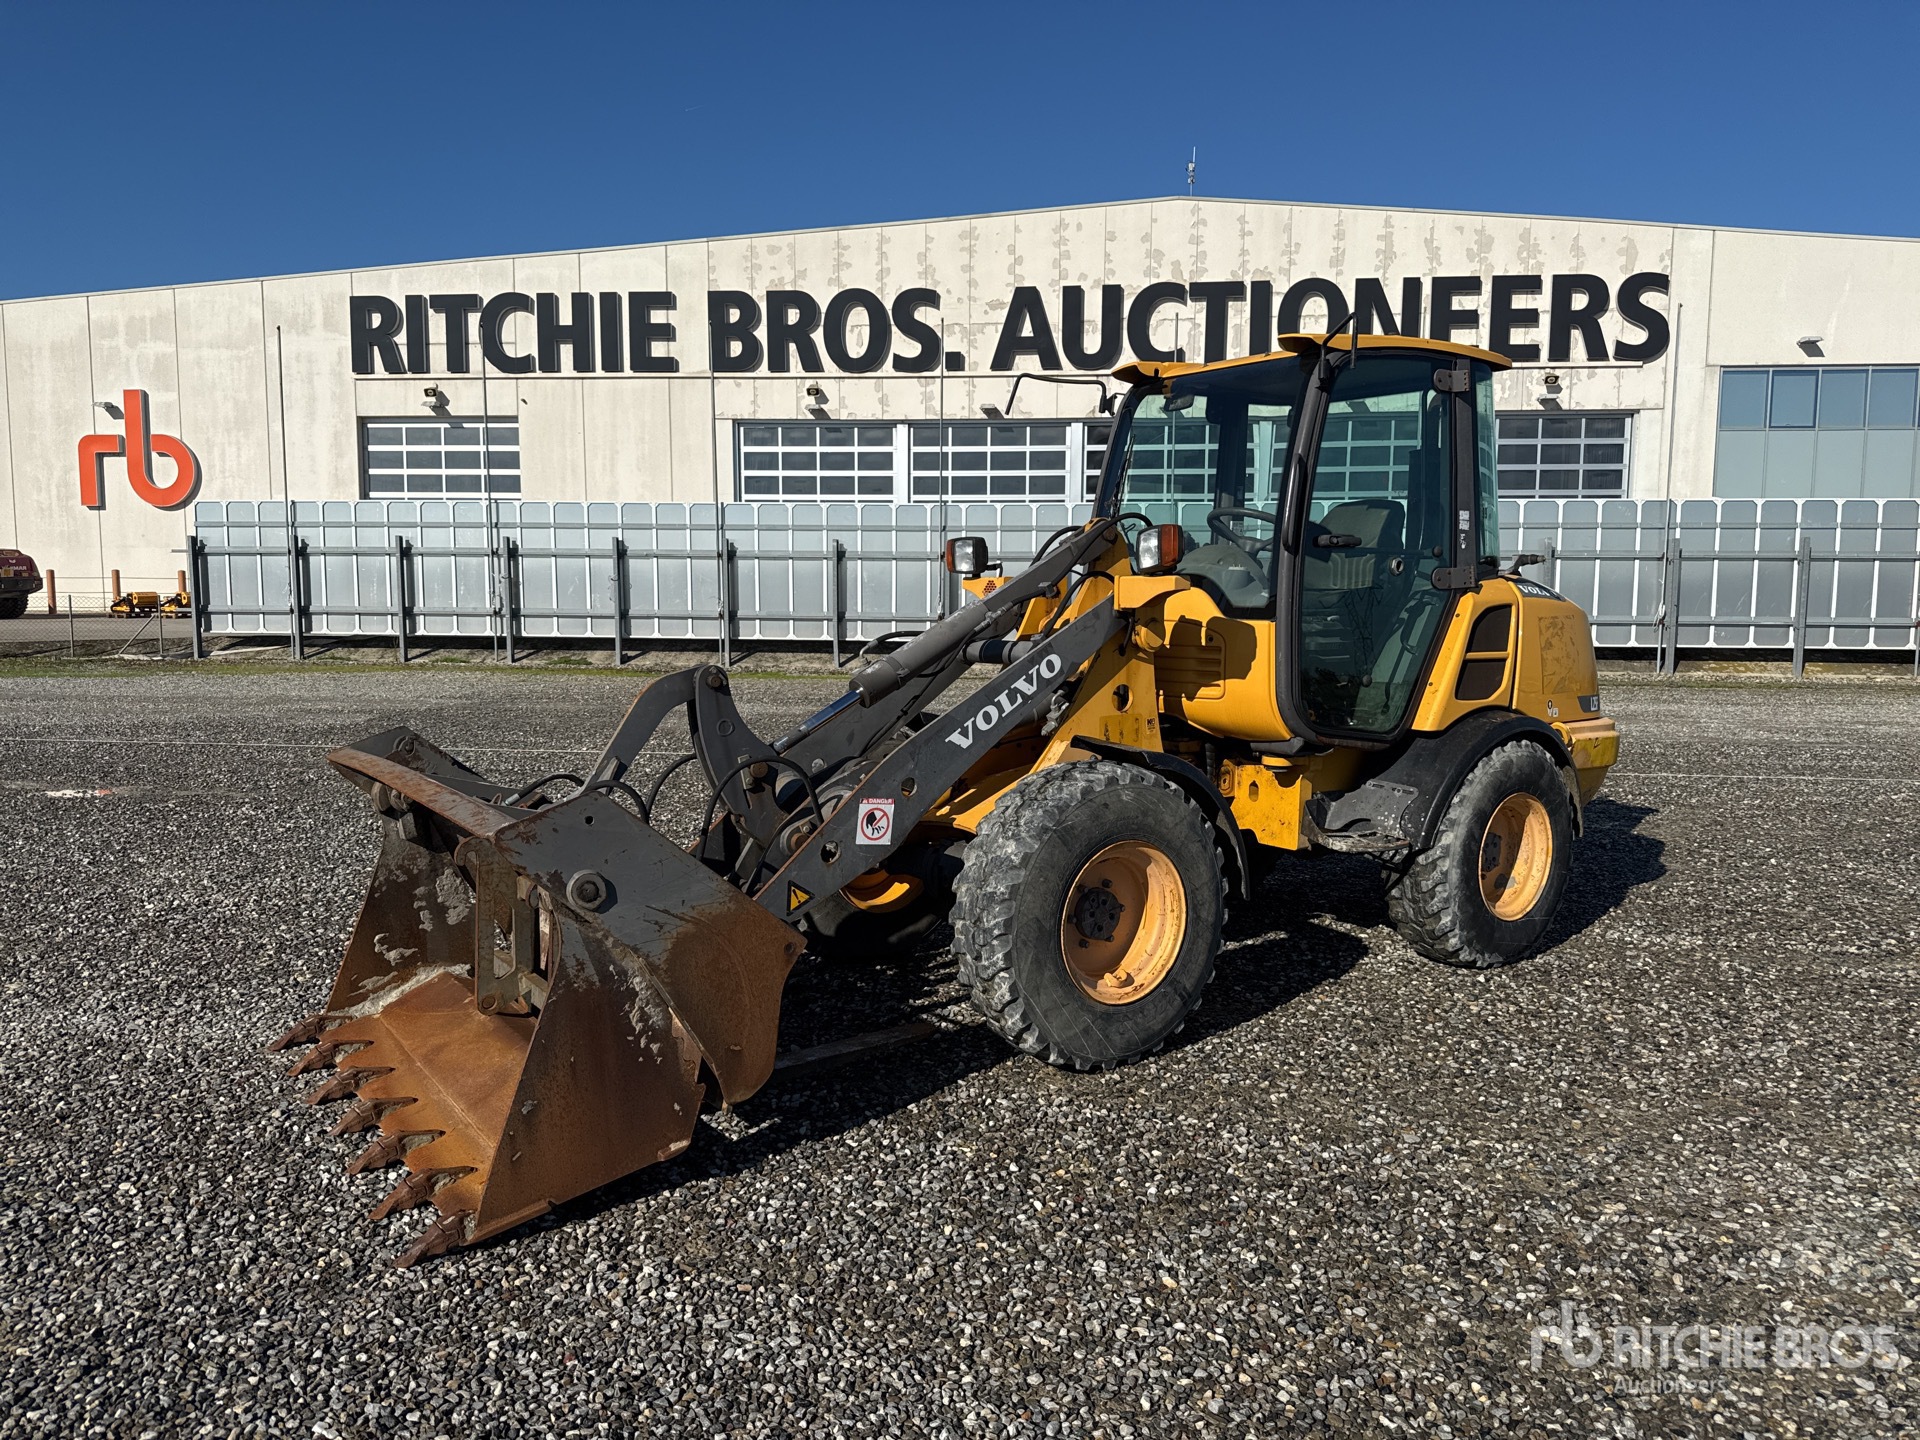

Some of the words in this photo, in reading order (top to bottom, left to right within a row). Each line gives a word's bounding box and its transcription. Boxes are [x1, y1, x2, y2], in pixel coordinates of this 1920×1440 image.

[350, 291, 677, 374] RITCHIE
[708, 288, 965, 374] BROS.
[989, 271, 1670, 372] AUCTIONEERS
[78, 389, 198, 508] rb
[944, 653, 1062, 749] VOLVO
